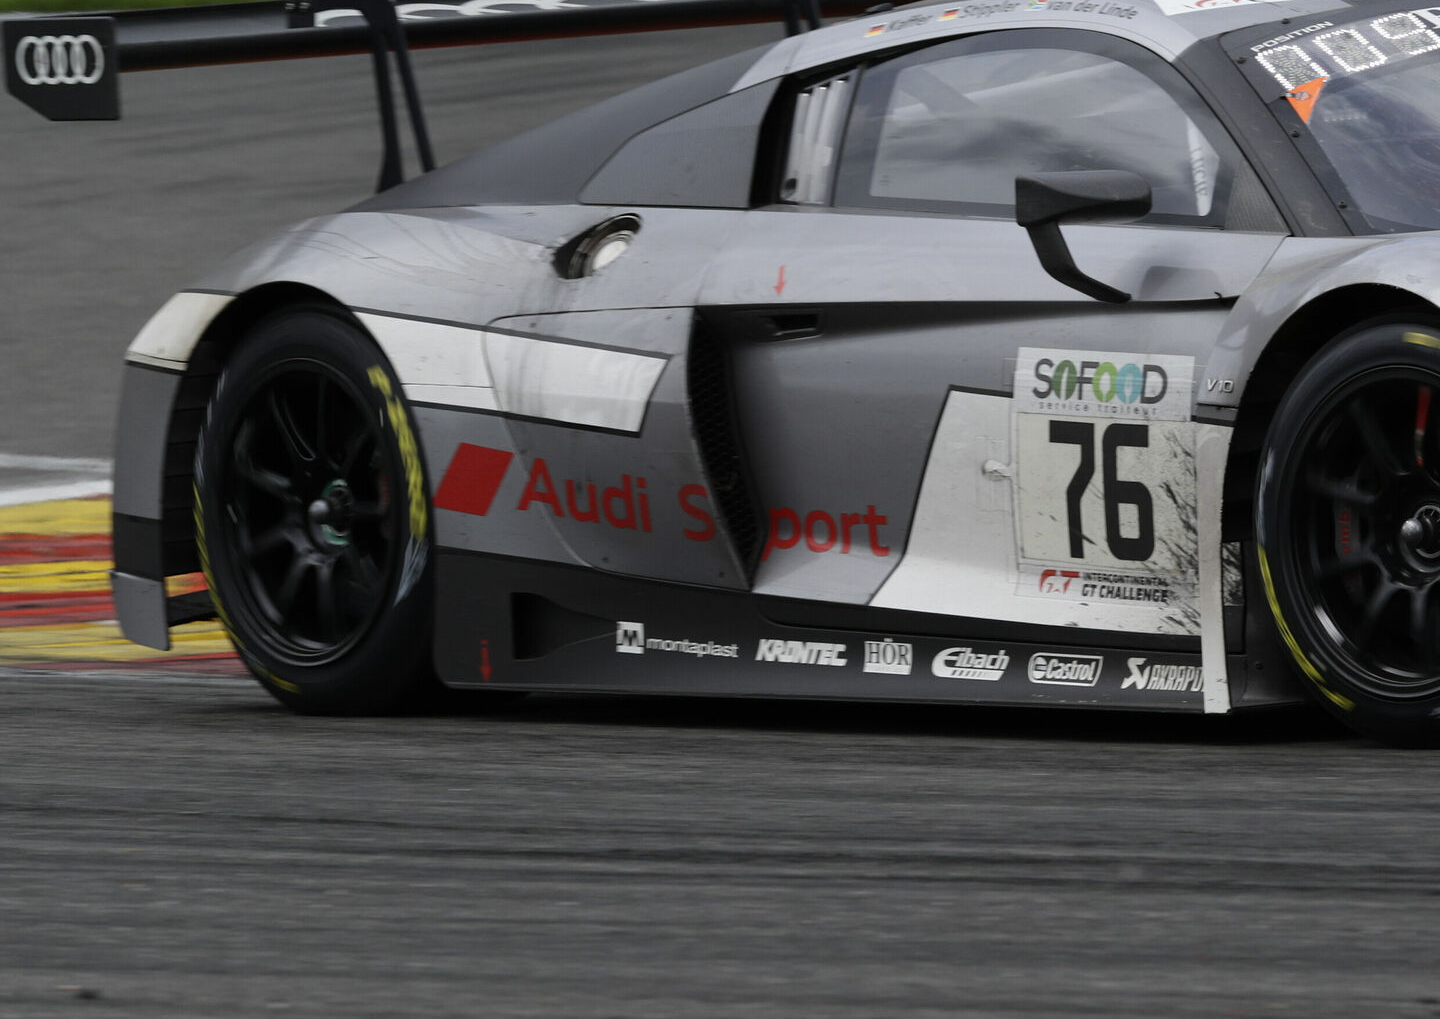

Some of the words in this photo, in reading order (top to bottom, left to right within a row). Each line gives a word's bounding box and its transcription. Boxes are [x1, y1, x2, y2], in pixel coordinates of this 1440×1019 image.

[1074, 0, 1098, 13] der
[1099, 3, 1138, 20] Linde
[1251, 21, 1334, 53] POSITION
[1032, 358, 1168, 404] SOFOOD
[1207, 378, 1234, 393] V10
[517, 457, 653, 533] Audi
[1049, 419, 1155, 562] 76
[1081, 583, 1098, 597] GT
[1099, 584, 1169, 604] CHALLENGE
[646, 637, 738, 659] montaplast
[864, 637, 913, 668] HÖR
[931, 647, 1010, 680] Eibach
[1046, 657, 1096, 681] Castrol
[1146, 664, 1205, 693] AKRAPO
